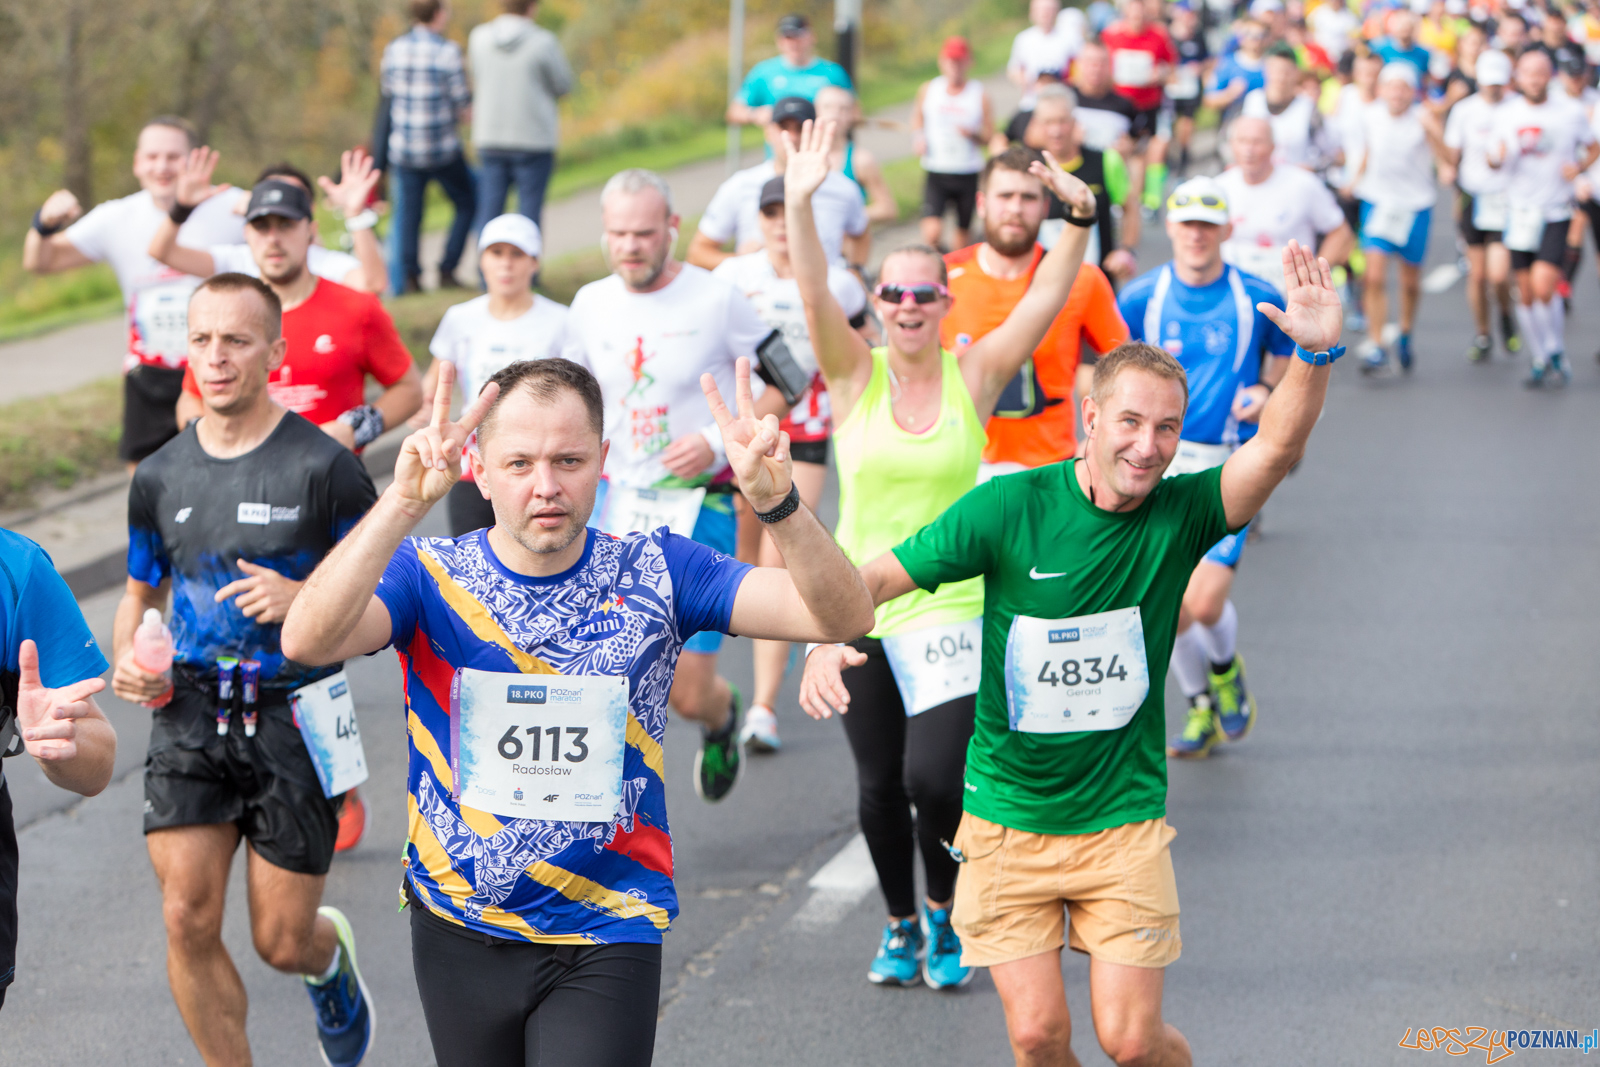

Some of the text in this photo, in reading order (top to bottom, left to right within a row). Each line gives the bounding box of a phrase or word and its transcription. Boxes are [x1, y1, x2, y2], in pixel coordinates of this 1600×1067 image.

[1051, 631, 1078, 640] 18. PKO
[925, 632, 973, 664] 604
[1037, 654, 1128, 687] 4834
[511, 690, 544, 699] 18. PKO
[1066, 687, 1102, 697] Gerard
[497, 725, 589, 763] 6113
[512, 763, 572, 776] Radosław
